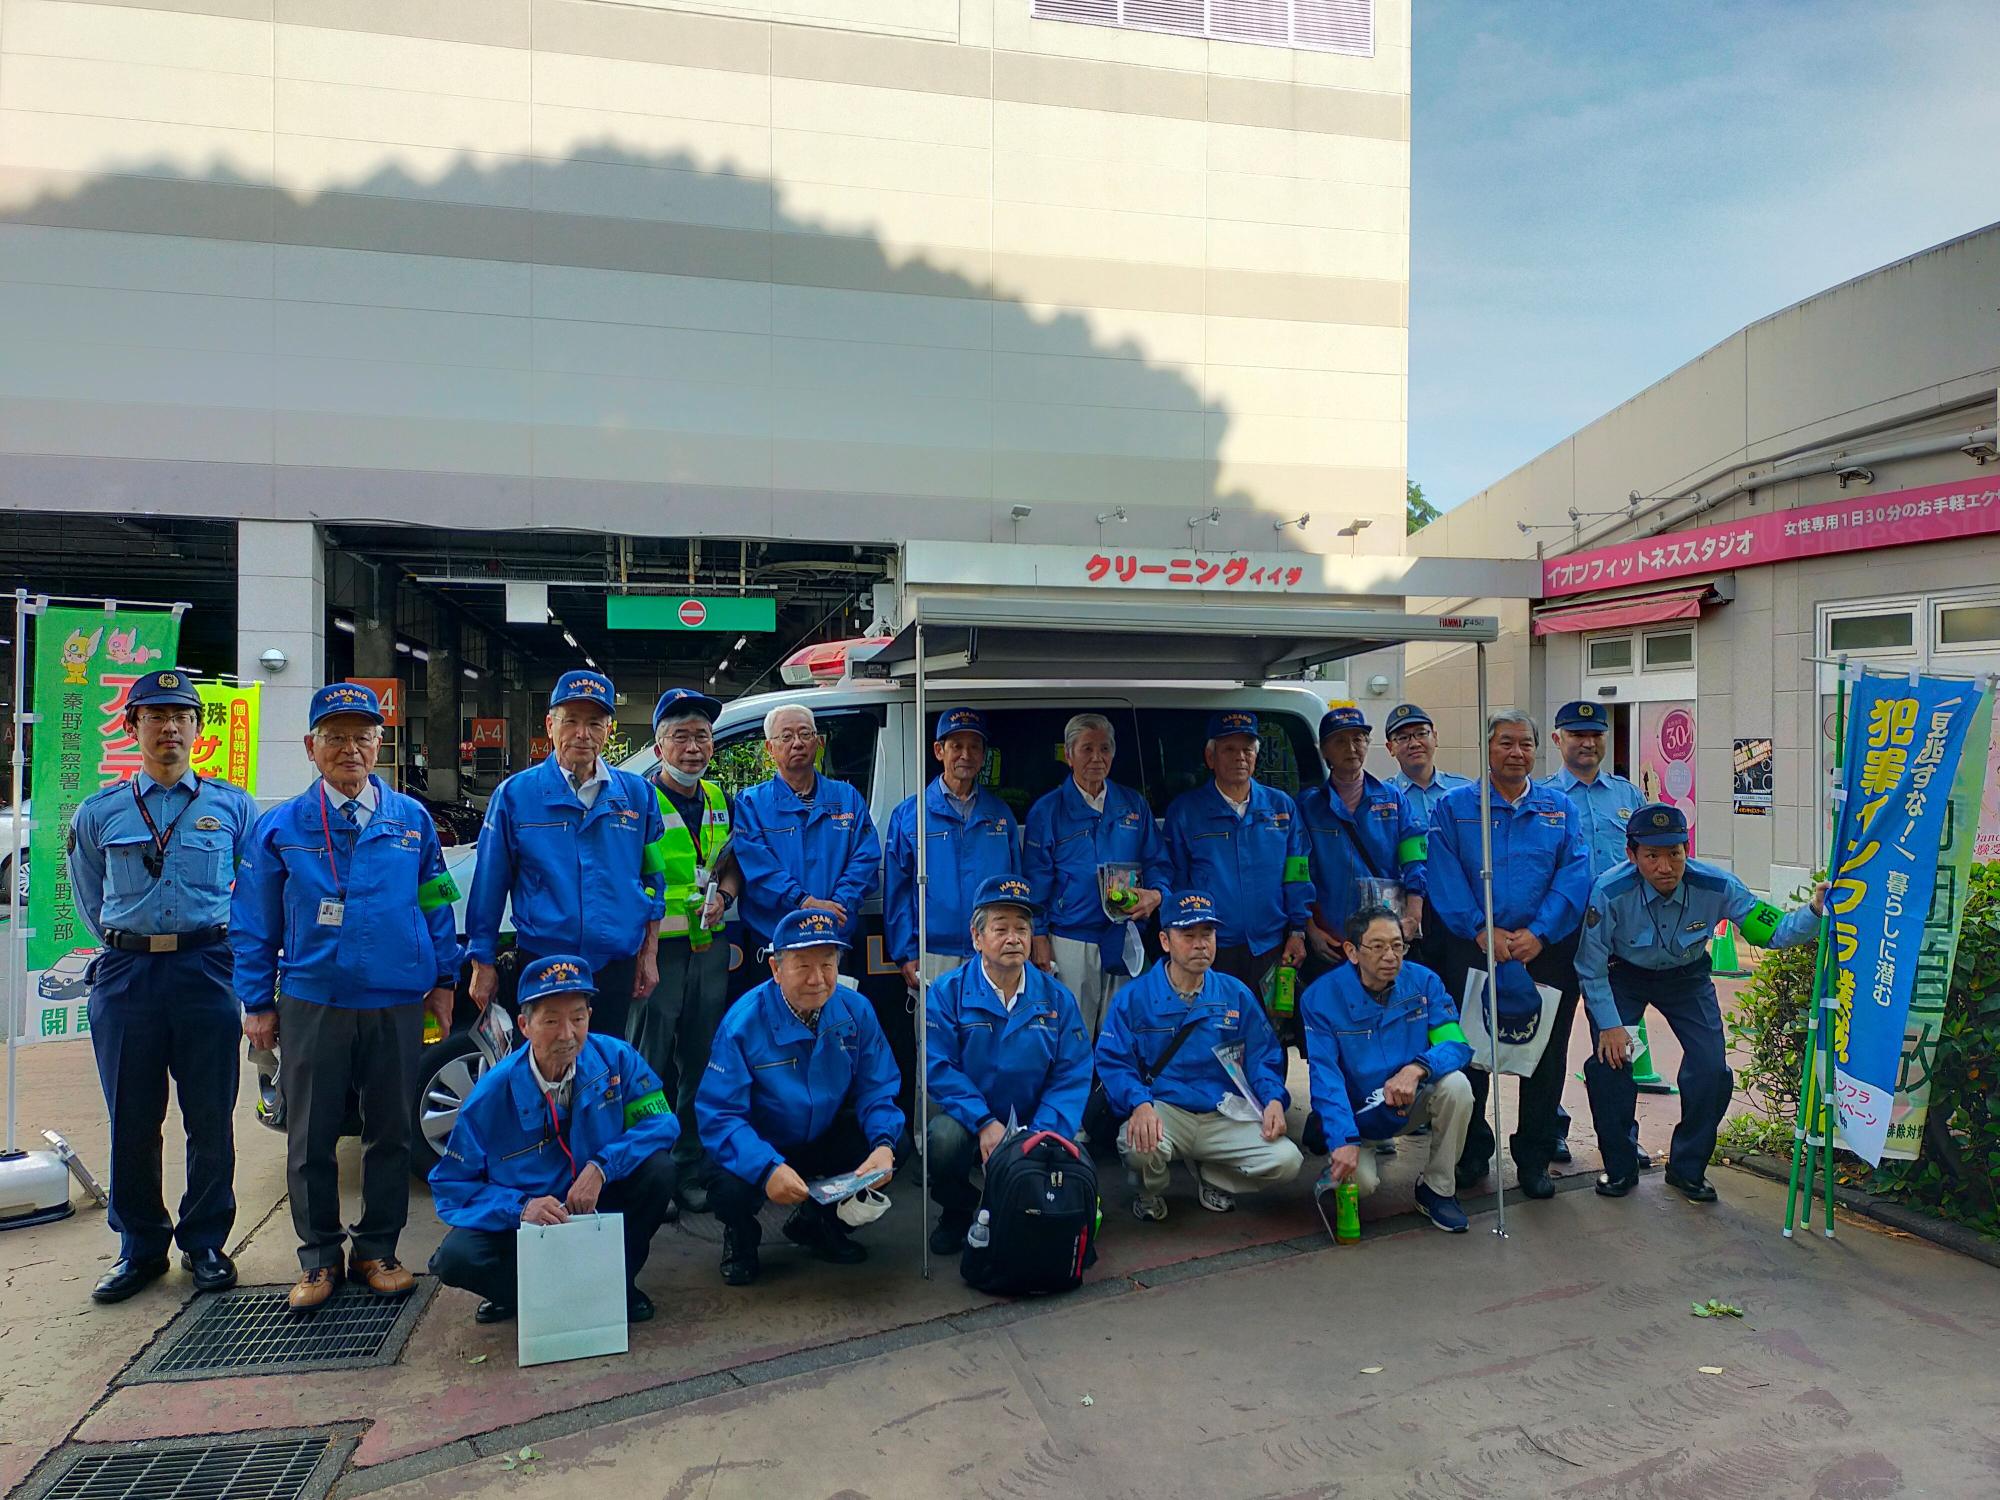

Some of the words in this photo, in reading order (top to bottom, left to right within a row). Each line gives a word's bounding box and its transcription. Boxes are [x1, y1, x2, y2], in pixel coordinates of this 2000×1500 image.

[1548, 529, 1754, 589] イオンフィットネススタジオ
[1440, 617, 1462, 628] FIAMMA
[569, 679, 605, 693] HADANO
[325, 689, 368, 702] HADANO
[473, 724, 501, 742] A-4
[1667, 725, 1685, 749] 30
[530, 742, 550, 755] A-4
[1179, 896, 1211, 907] HADANO
[1872, 870, 1909, 1007] 暮らしに潜む
